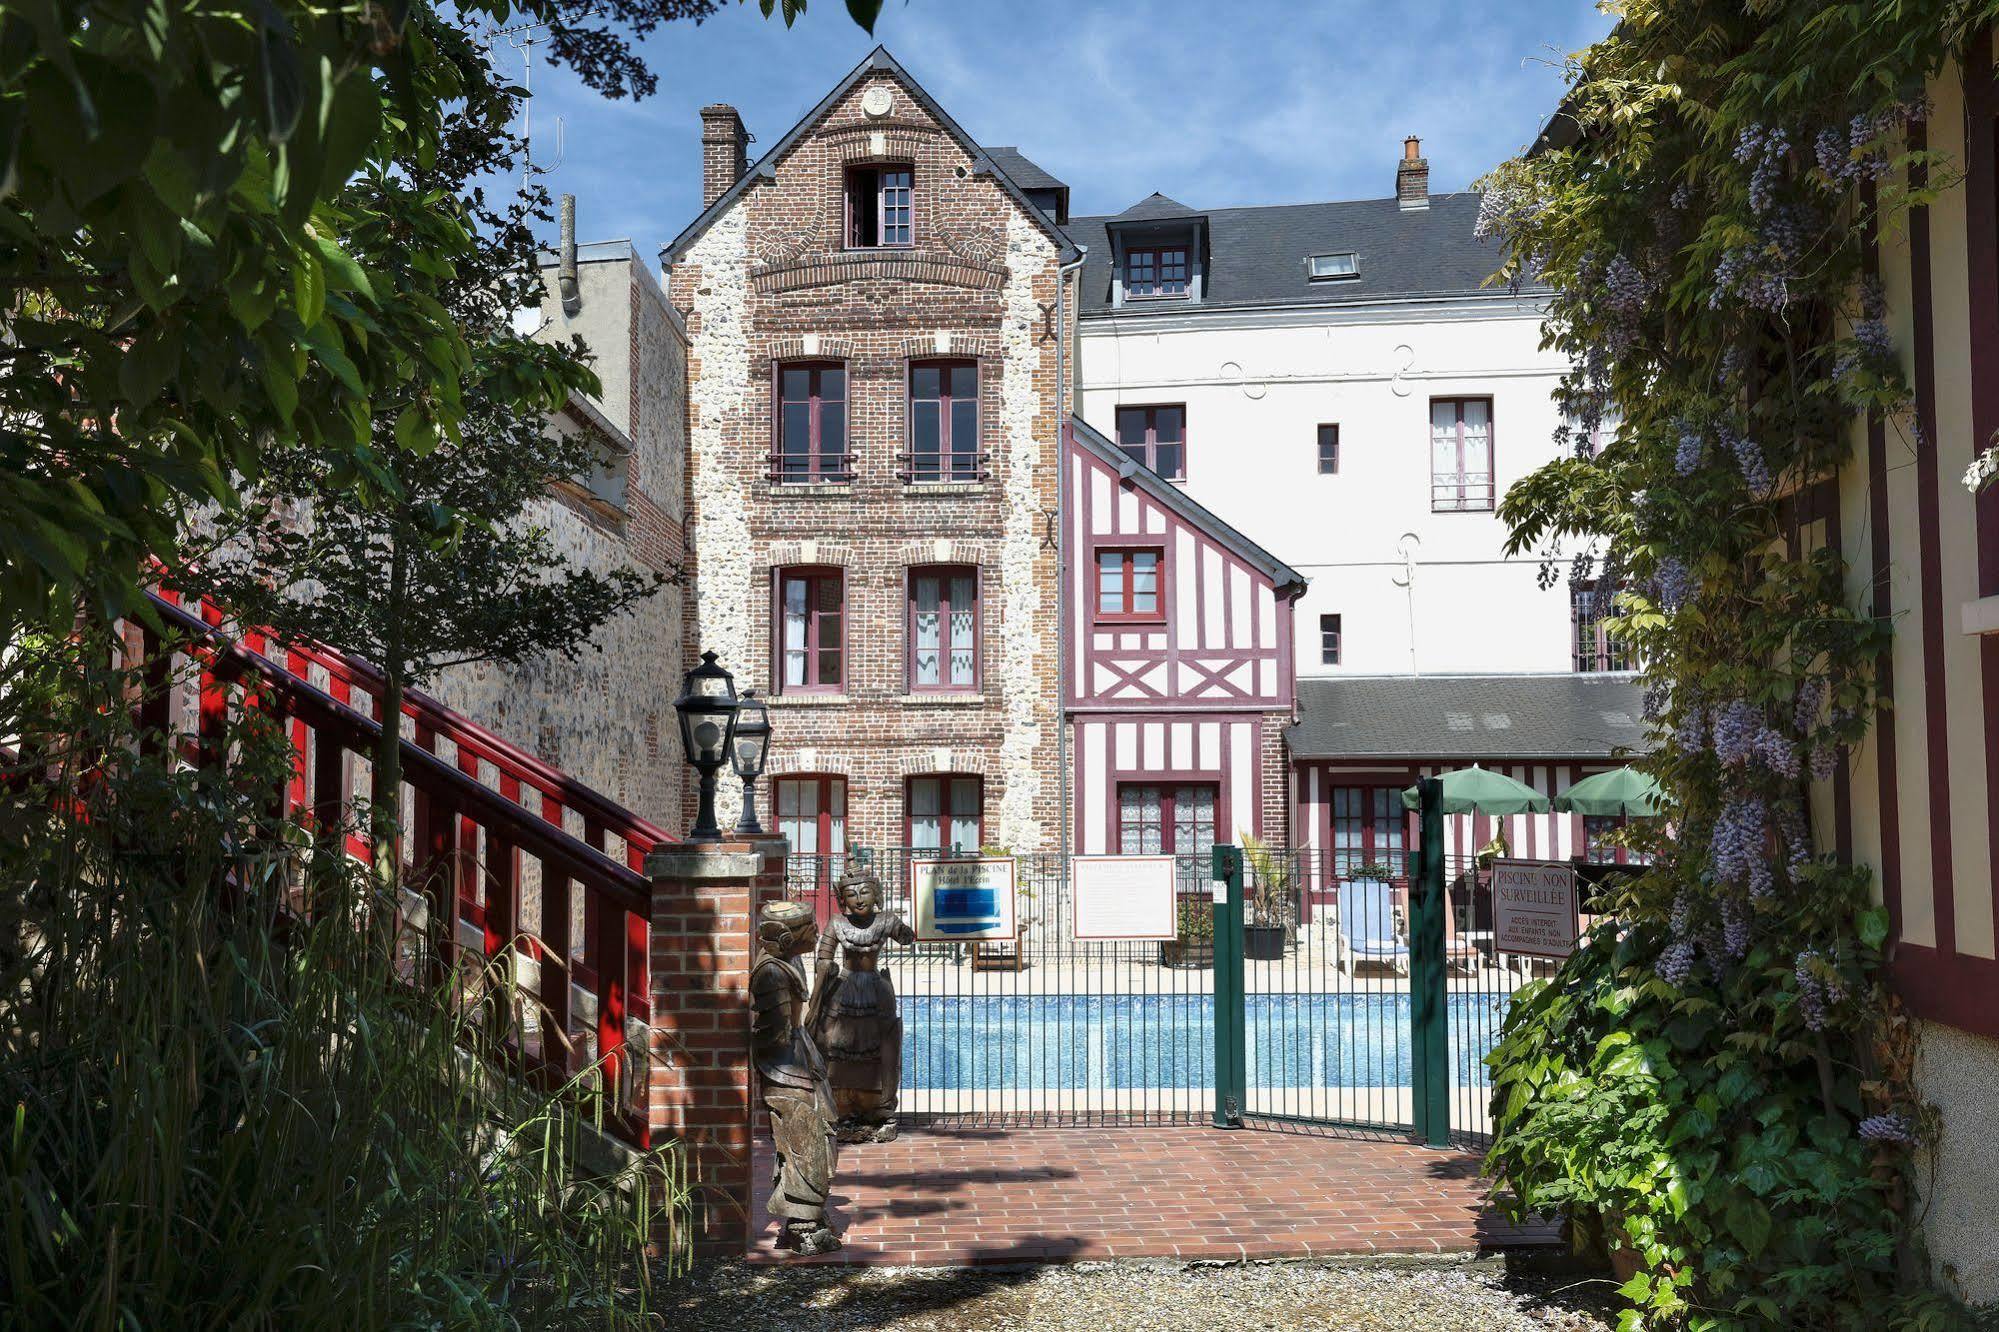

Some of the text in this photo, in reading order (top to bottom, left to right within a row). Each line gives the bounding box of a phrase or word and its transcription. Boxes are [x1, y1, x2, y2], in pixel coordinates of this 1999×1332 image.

[920, 864, 1009, 875] PLAN de la PISCINE
[1543, 873, 1567, 887] NON
[1501, 888, 1565, 905] SURVEILLÉE
[1531, 918, 1557, 927] INTERDIT
[1508, 926, 1561, 937] AUX ENFANTS NON
